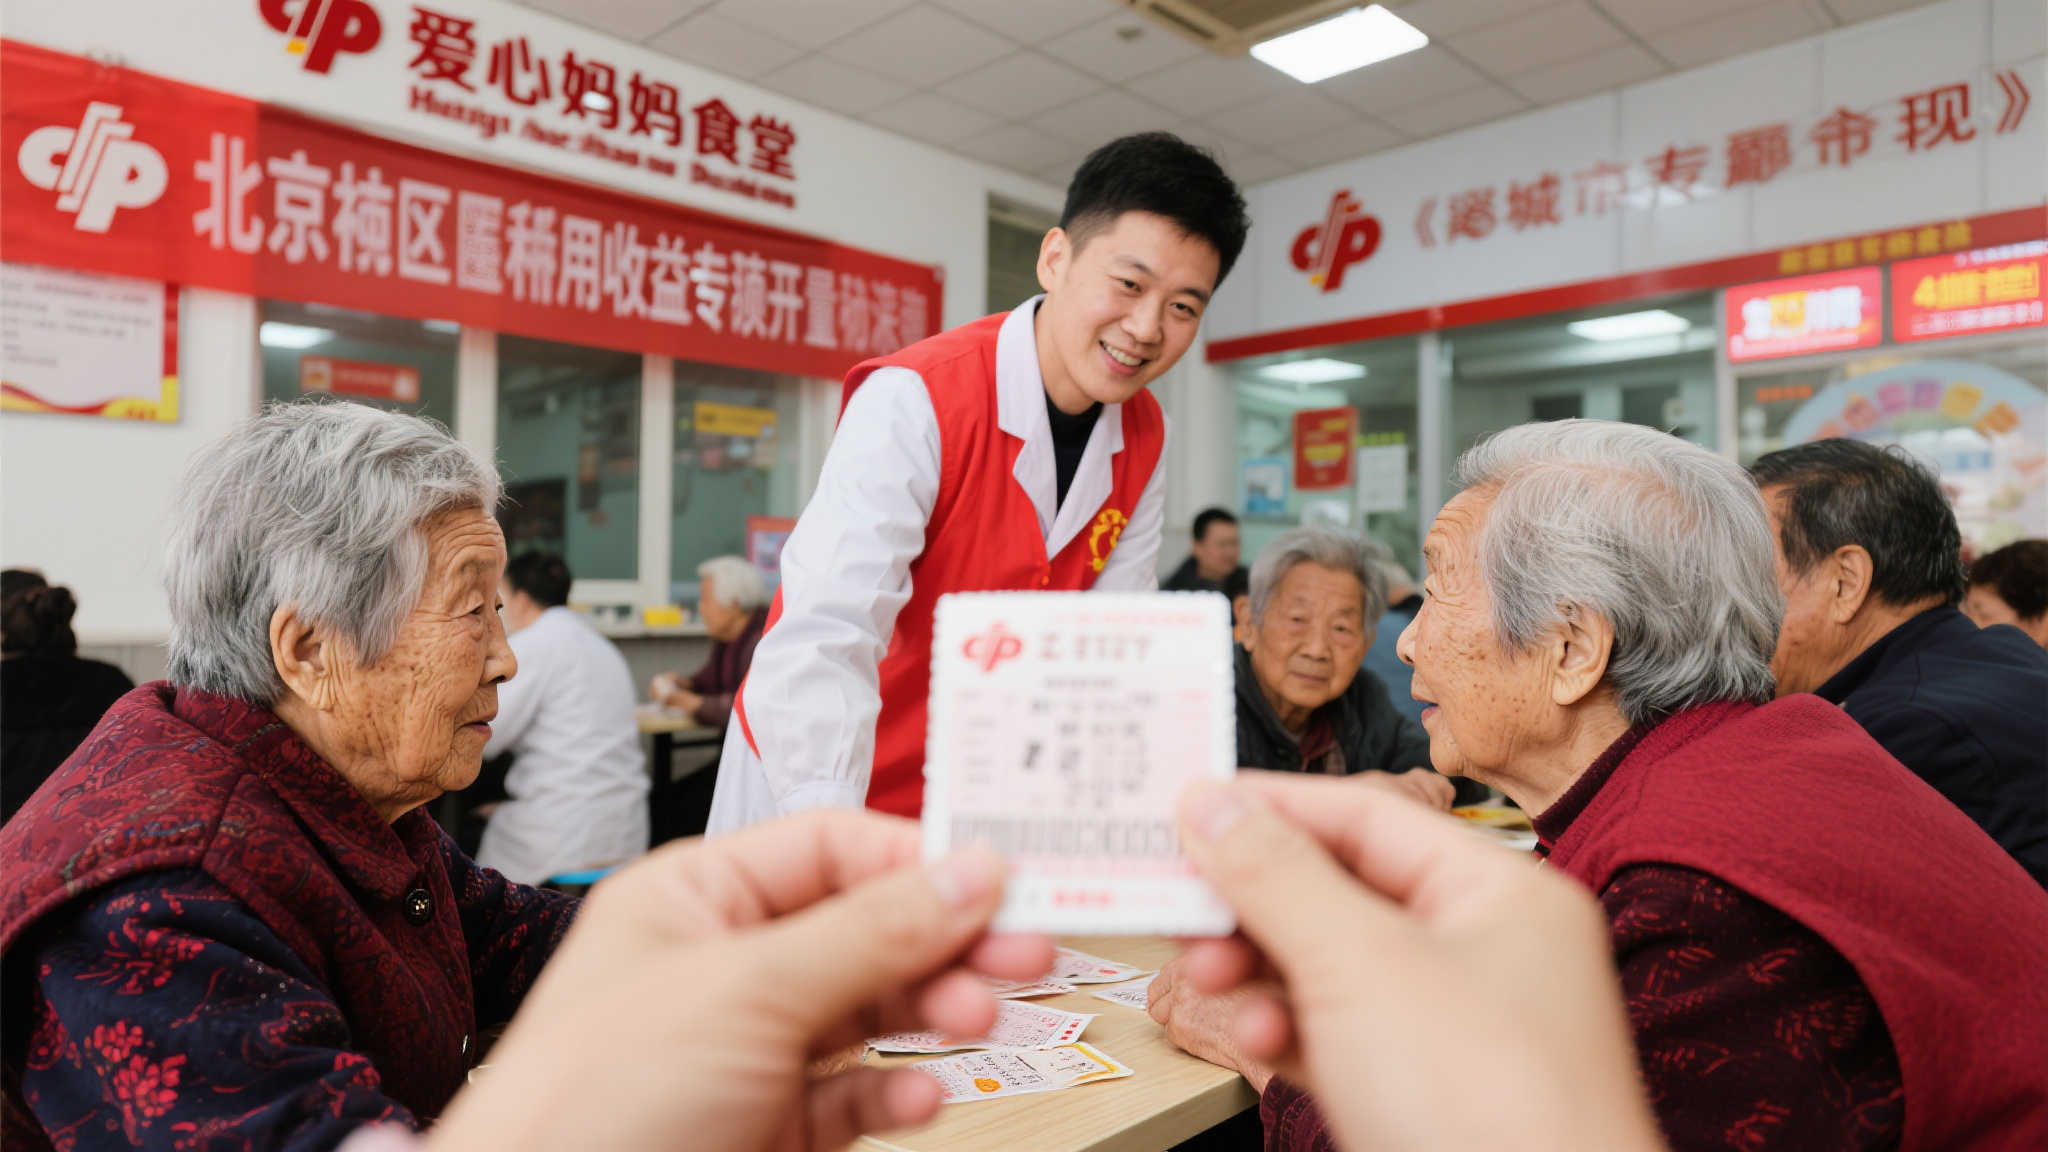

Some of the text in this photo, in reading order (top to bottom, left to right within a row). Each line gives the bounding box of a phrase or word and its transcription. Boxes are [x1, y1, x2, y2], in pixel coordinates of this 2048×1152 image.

[408, 6, 797, 180] 爱心妈妈食堂
